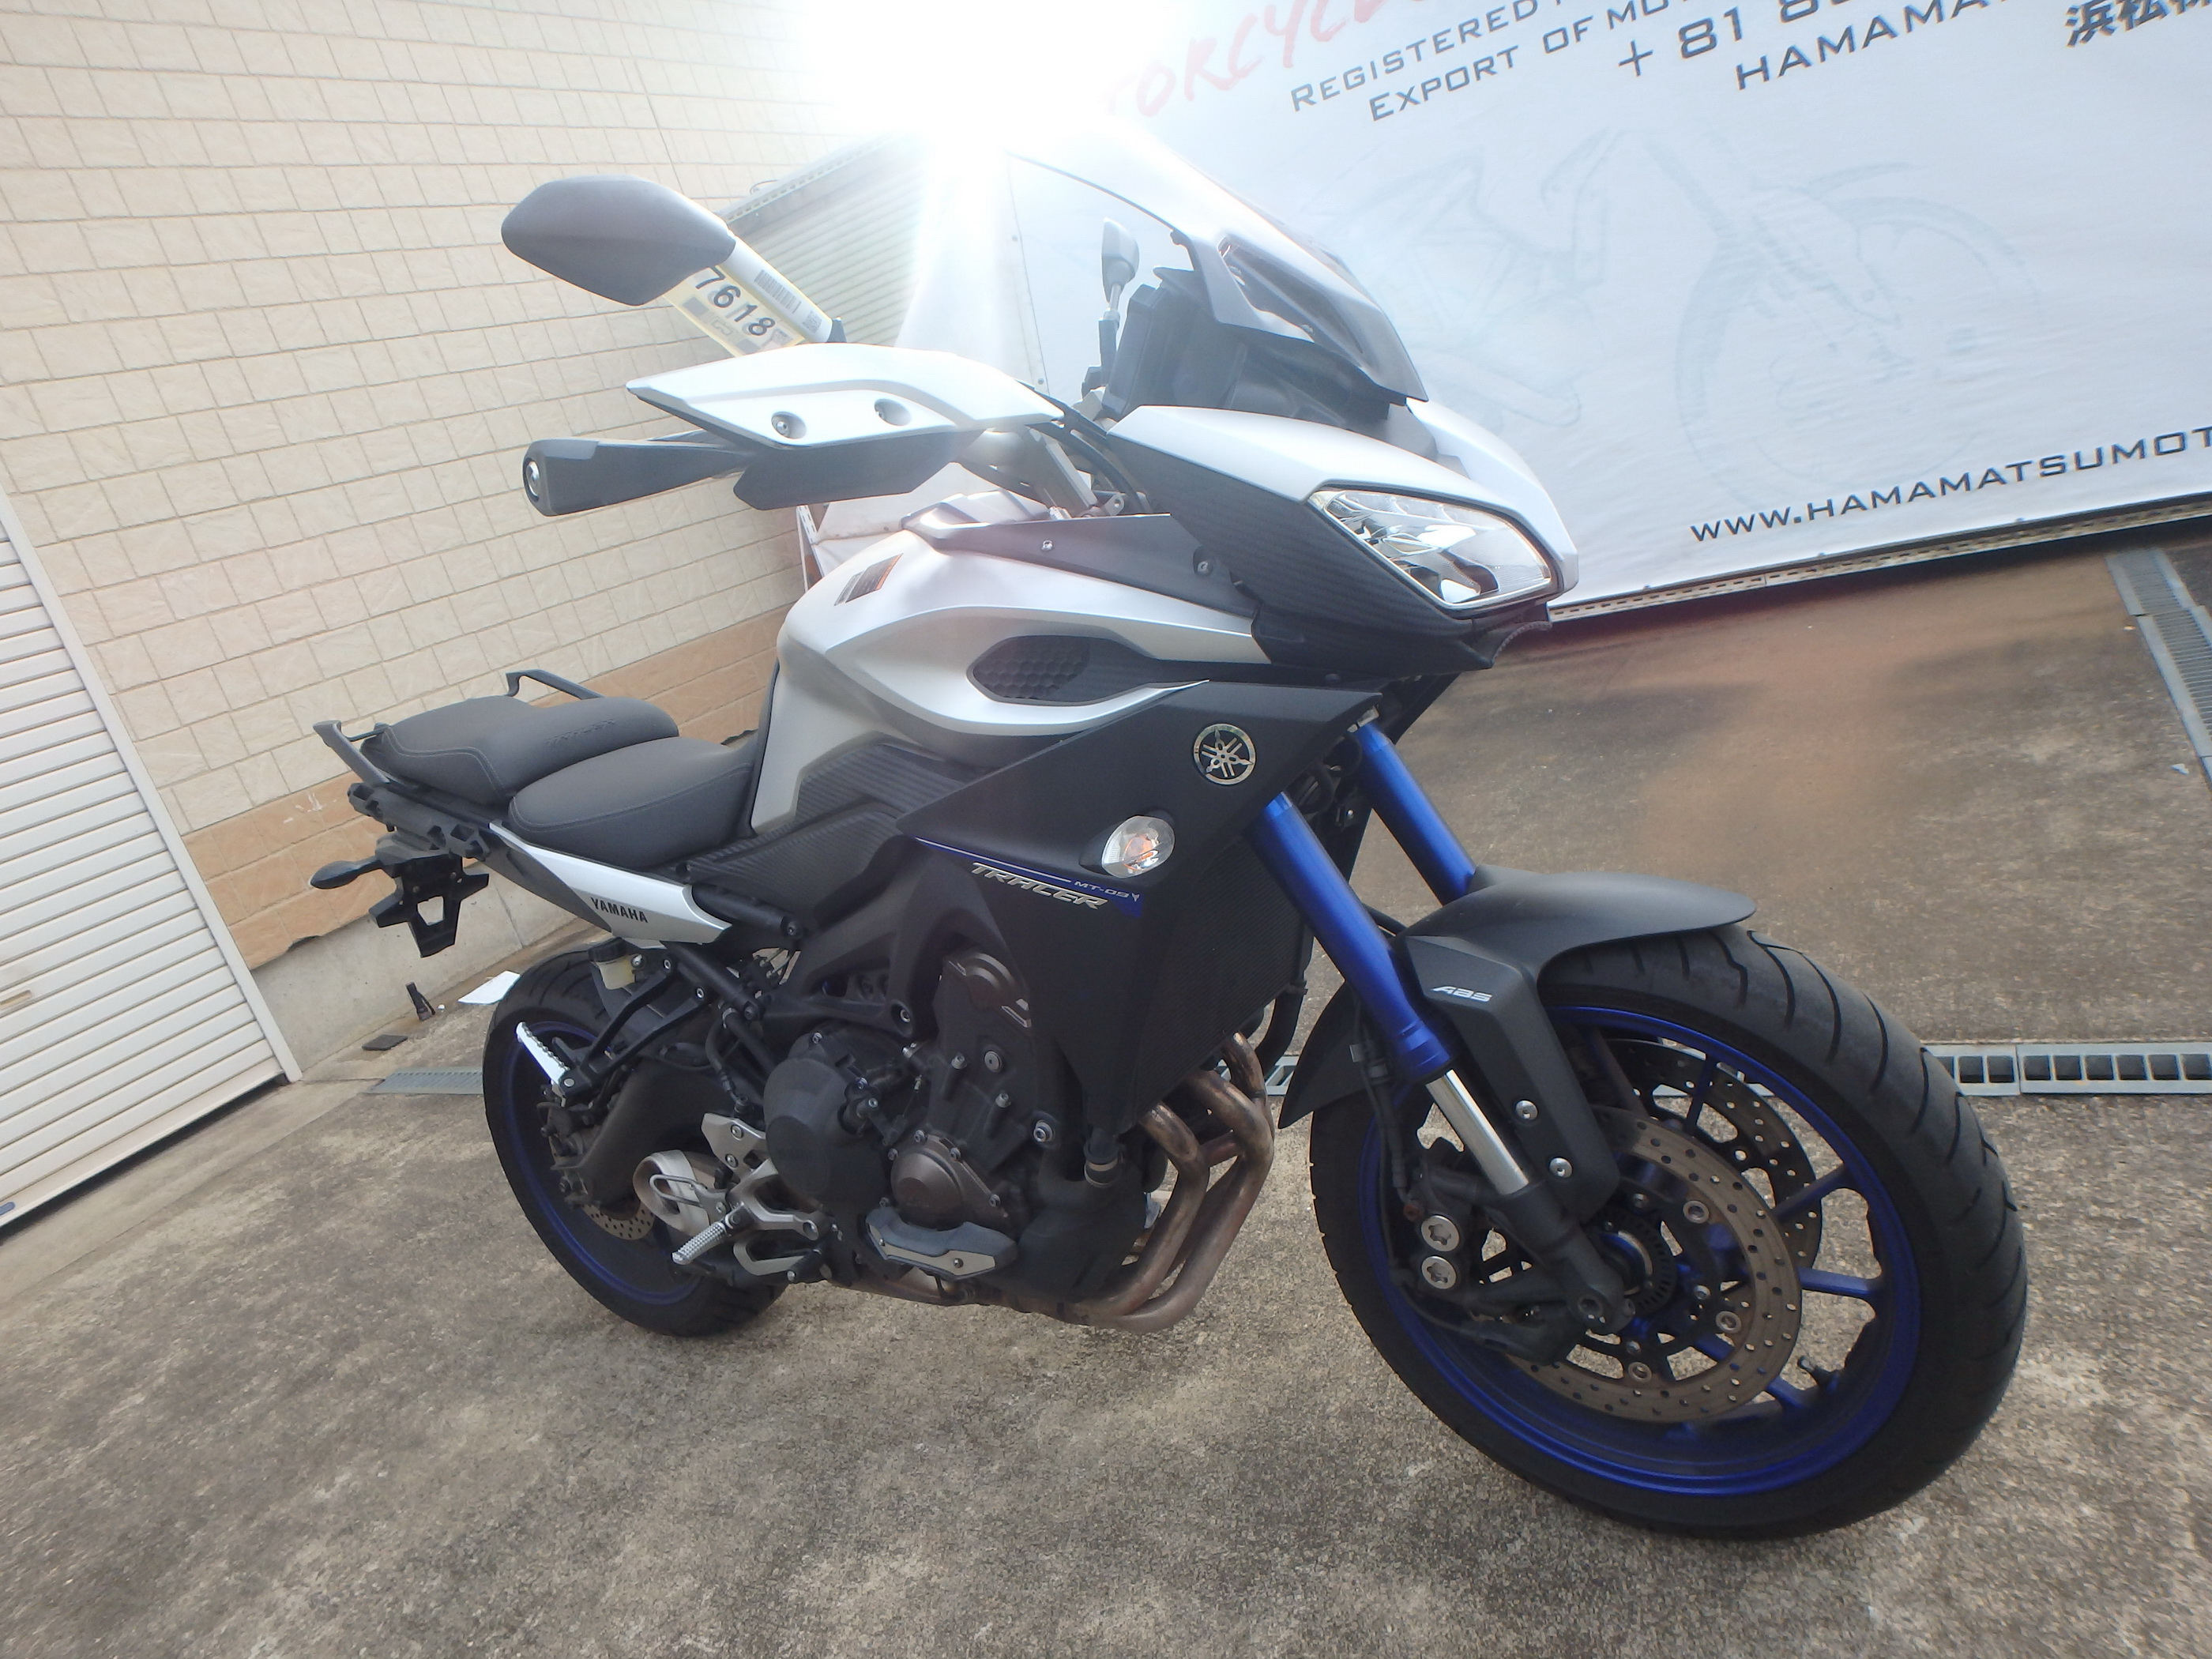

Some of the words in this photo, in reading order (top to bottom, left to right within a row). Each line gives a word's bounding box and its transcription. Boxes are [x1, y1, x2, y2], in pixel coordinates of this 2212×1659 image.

[1290, 0, 1538, 112] REGISTERED
[1678, 6, 1743, 59] 81
[1736, 0, 2008, 91] HAMAMA
[1369, 45, 1518, 121] EXPORT
[1543, 15, 1594, 54] OF
[695, 265, 777, 337] 7618
[590, 897, 649, 924] YAMAHA
[971, 862, 1108, 910] TRACER
[1074, 880, 1130, 898] MT-09
[1430, 985, 1493, 1003] ABS
